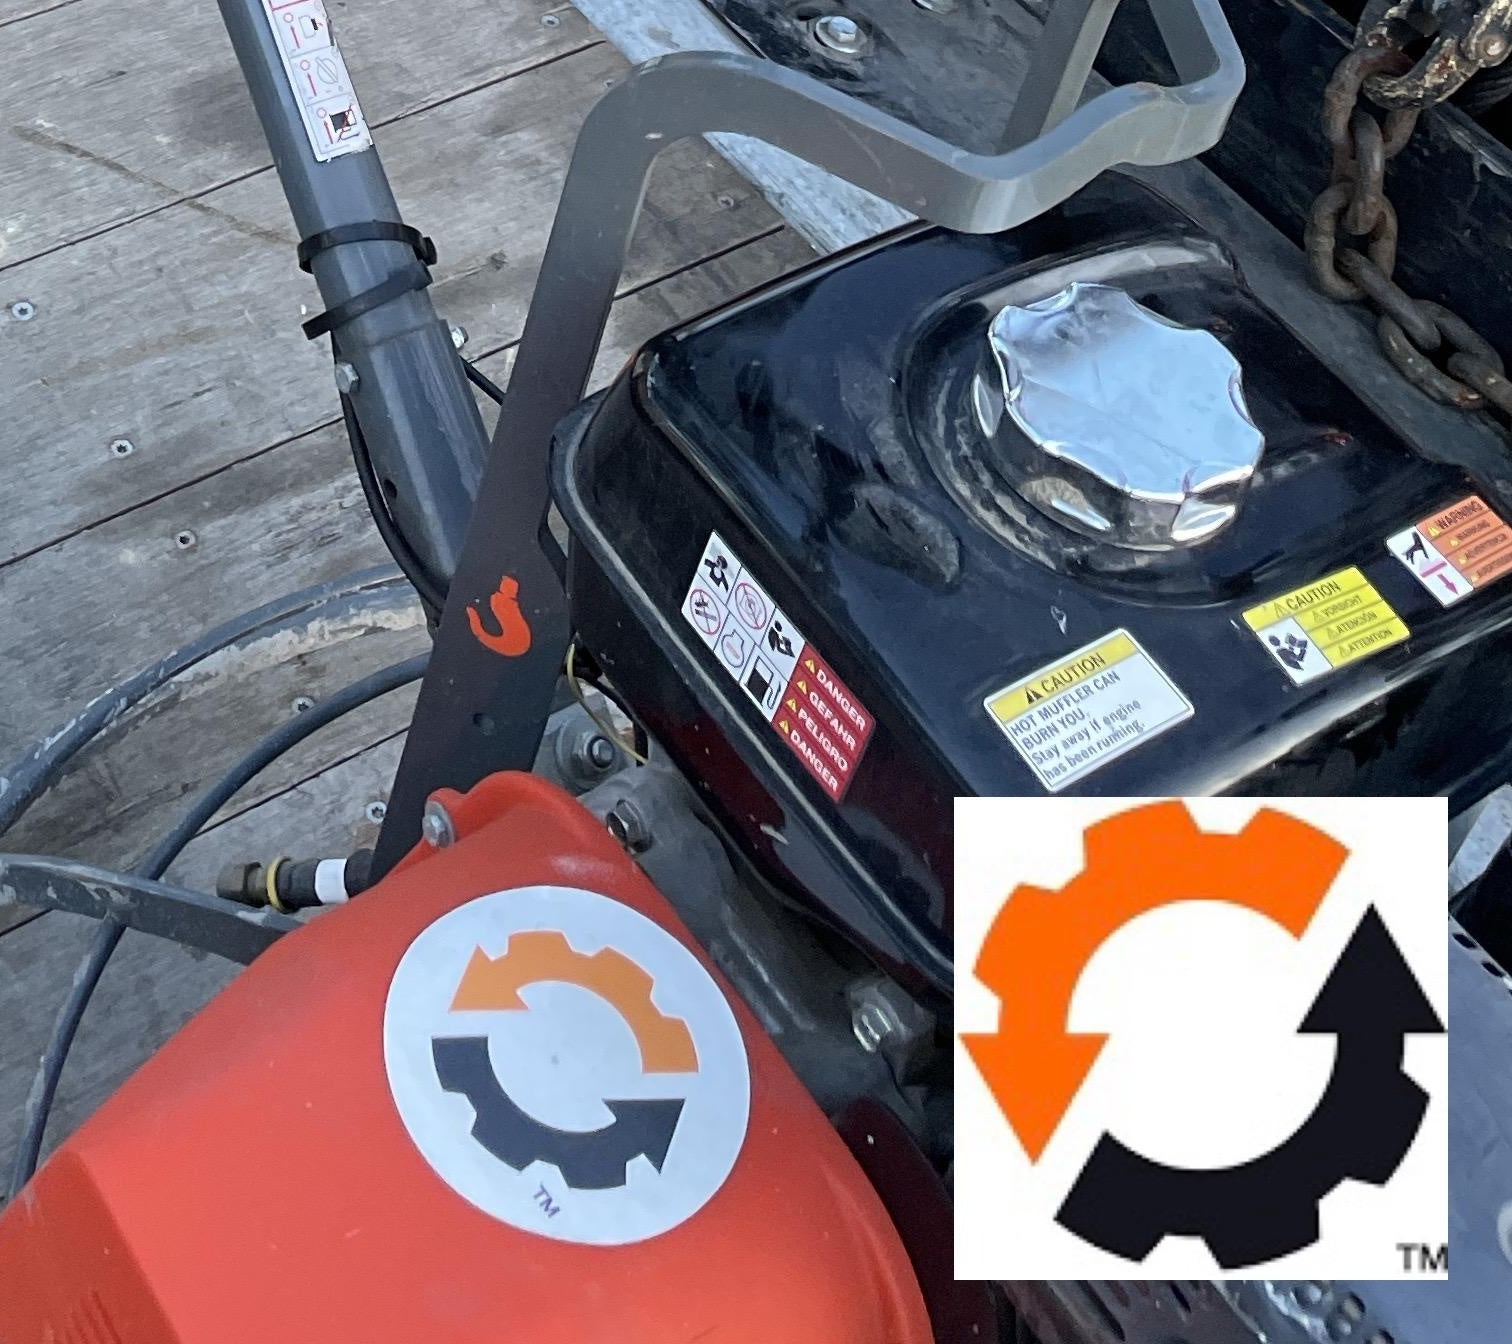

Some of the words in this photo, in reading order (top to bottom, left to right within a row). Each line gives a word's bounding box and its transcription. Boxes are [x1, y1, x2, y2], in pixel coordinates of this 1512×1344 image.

[1285, 580, 1342, 610] CAUTION
[816, 668, 866, 732] DANGER
[1010, 716, 1039, 736] HOT
[1039, 684, 1094, 725] MUFFLER
[1093, 670, 1120, 691] CAN
[1040, 652, 1106, 694] CAUTION
[797, 707, 848, 772] PELIGRO
[808, 691, 857, 751] GEFAHR
[1022, 722, 1060, 751] BURN
[1031, 745, 1061, 765] Stay
[1062, 730, 1092, 750] away
[1092, 721, 1102, 735] if
[1102, 700, 1142, 732] engine
[790, 728, 838, 792] DANGER
[1042, 761, 1067, 781] has
[1064, 745, 1098, 769] been
[533, 1183, 561, 1220] TM
